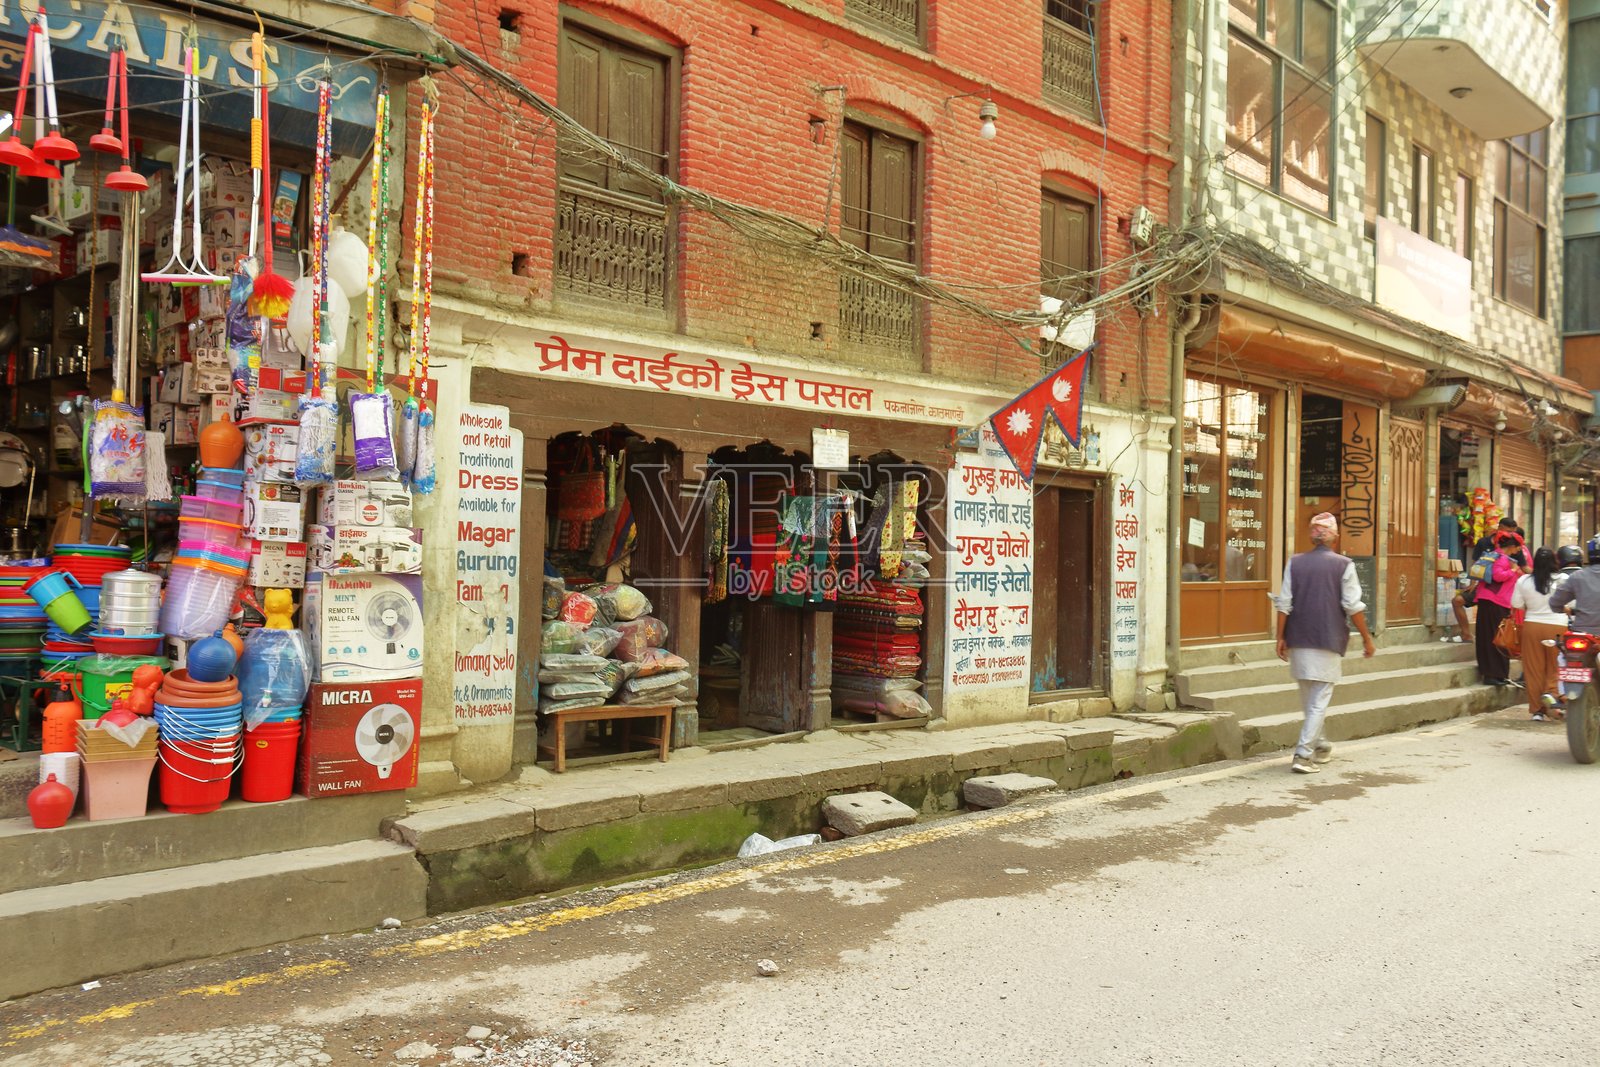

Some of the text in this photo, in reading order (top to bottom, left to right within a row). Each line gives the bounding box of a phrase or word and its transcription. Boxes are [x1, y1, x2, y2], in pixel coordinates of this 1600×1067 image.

[534, 335, 873, 412] प्रेम दाईको ड्रेस पसल
[460, 412, 503, 430] Wholesale
[462, 433, 511, 449] and Retail
[459, 451, 514, 469] Traditional
[337, 482, 366, 490] Hawkins
[458, 469, 519, 491] Dress
[1119, 483, 1135, 508] प्रेम
[1237, 487, 1245, 500] Day
[1245, 488, 1262, 499] Breakfast
[458, 497, 516, 513] Available for
[457, 521, 516, 548] Magar
[1115, 513, 1138, 540] दाईको
[956, 535, 995, 566] गुन्यु
[1116, 543, 1137, 572] ड्रेस
[457, 550, 517, 577] Gurung
[328, 579, 373, 590] DIAMOND
[1115, 581, 1137, 599] पसल
[334, 594, 357, 602] MINT
[953, 598, 983, 631] दौरा
[322, 690, 373, 706] MICRA
[464, 685, 469, 701] &
[471, 684, 513, 701] Ornaments
[318, 780, 362, 791] WALL FAN
